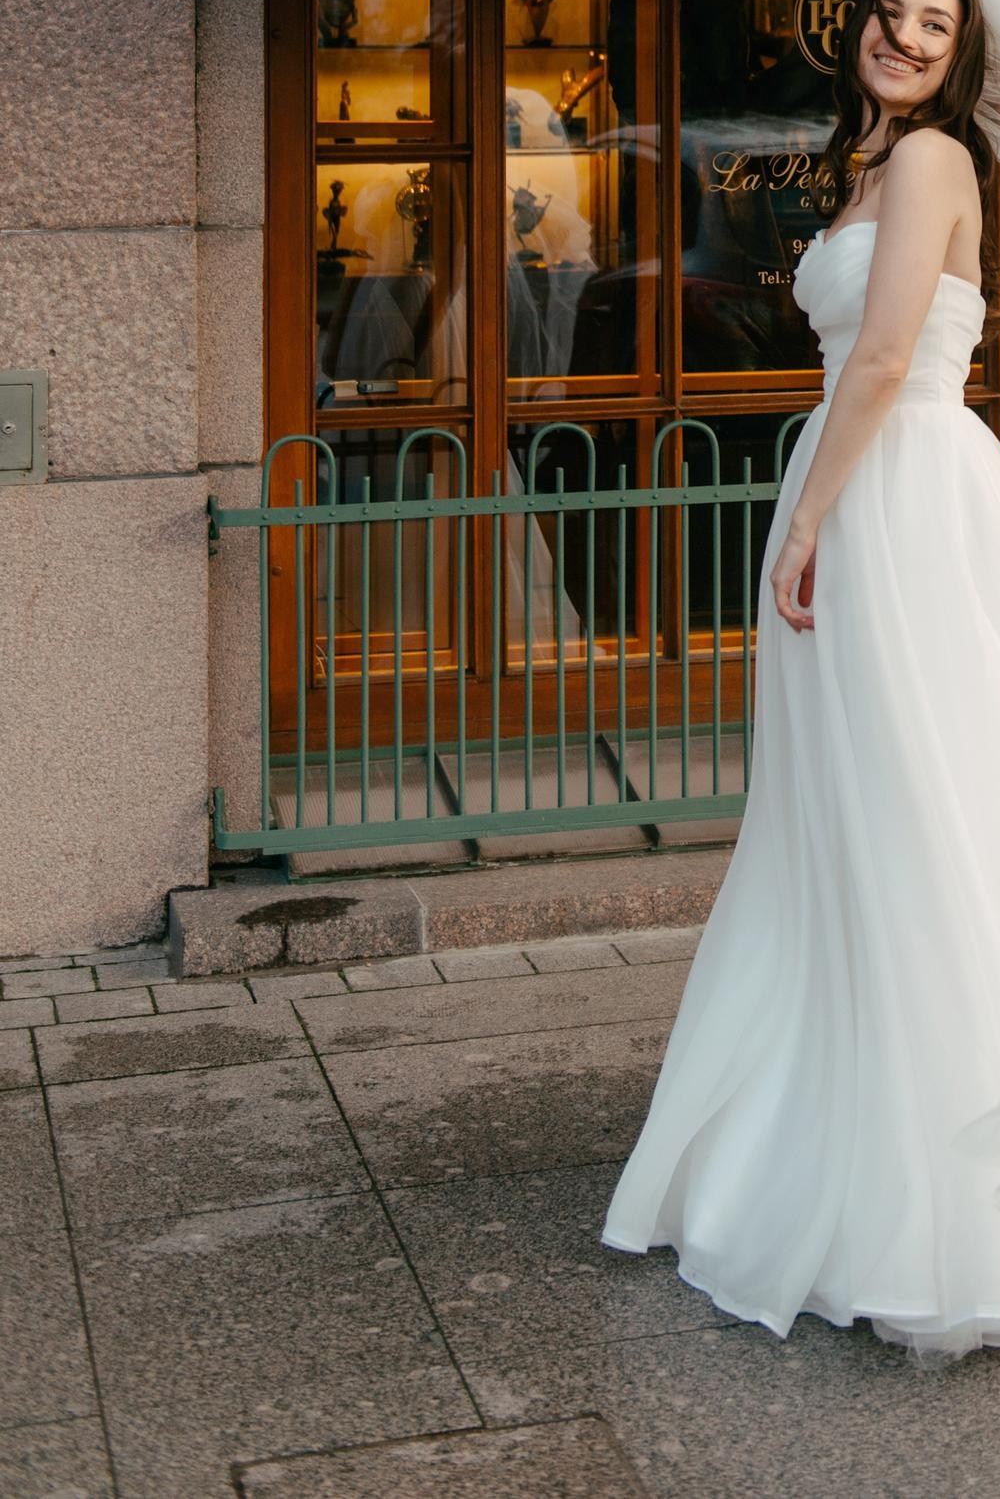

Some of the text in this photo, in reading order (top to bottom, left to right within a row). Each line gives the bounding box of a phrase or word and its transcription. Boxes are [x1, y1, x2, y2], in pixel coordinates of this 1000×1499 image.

[708, 151, 857, 192] La Petie
[757, 271, 792, 285] Tel.:
